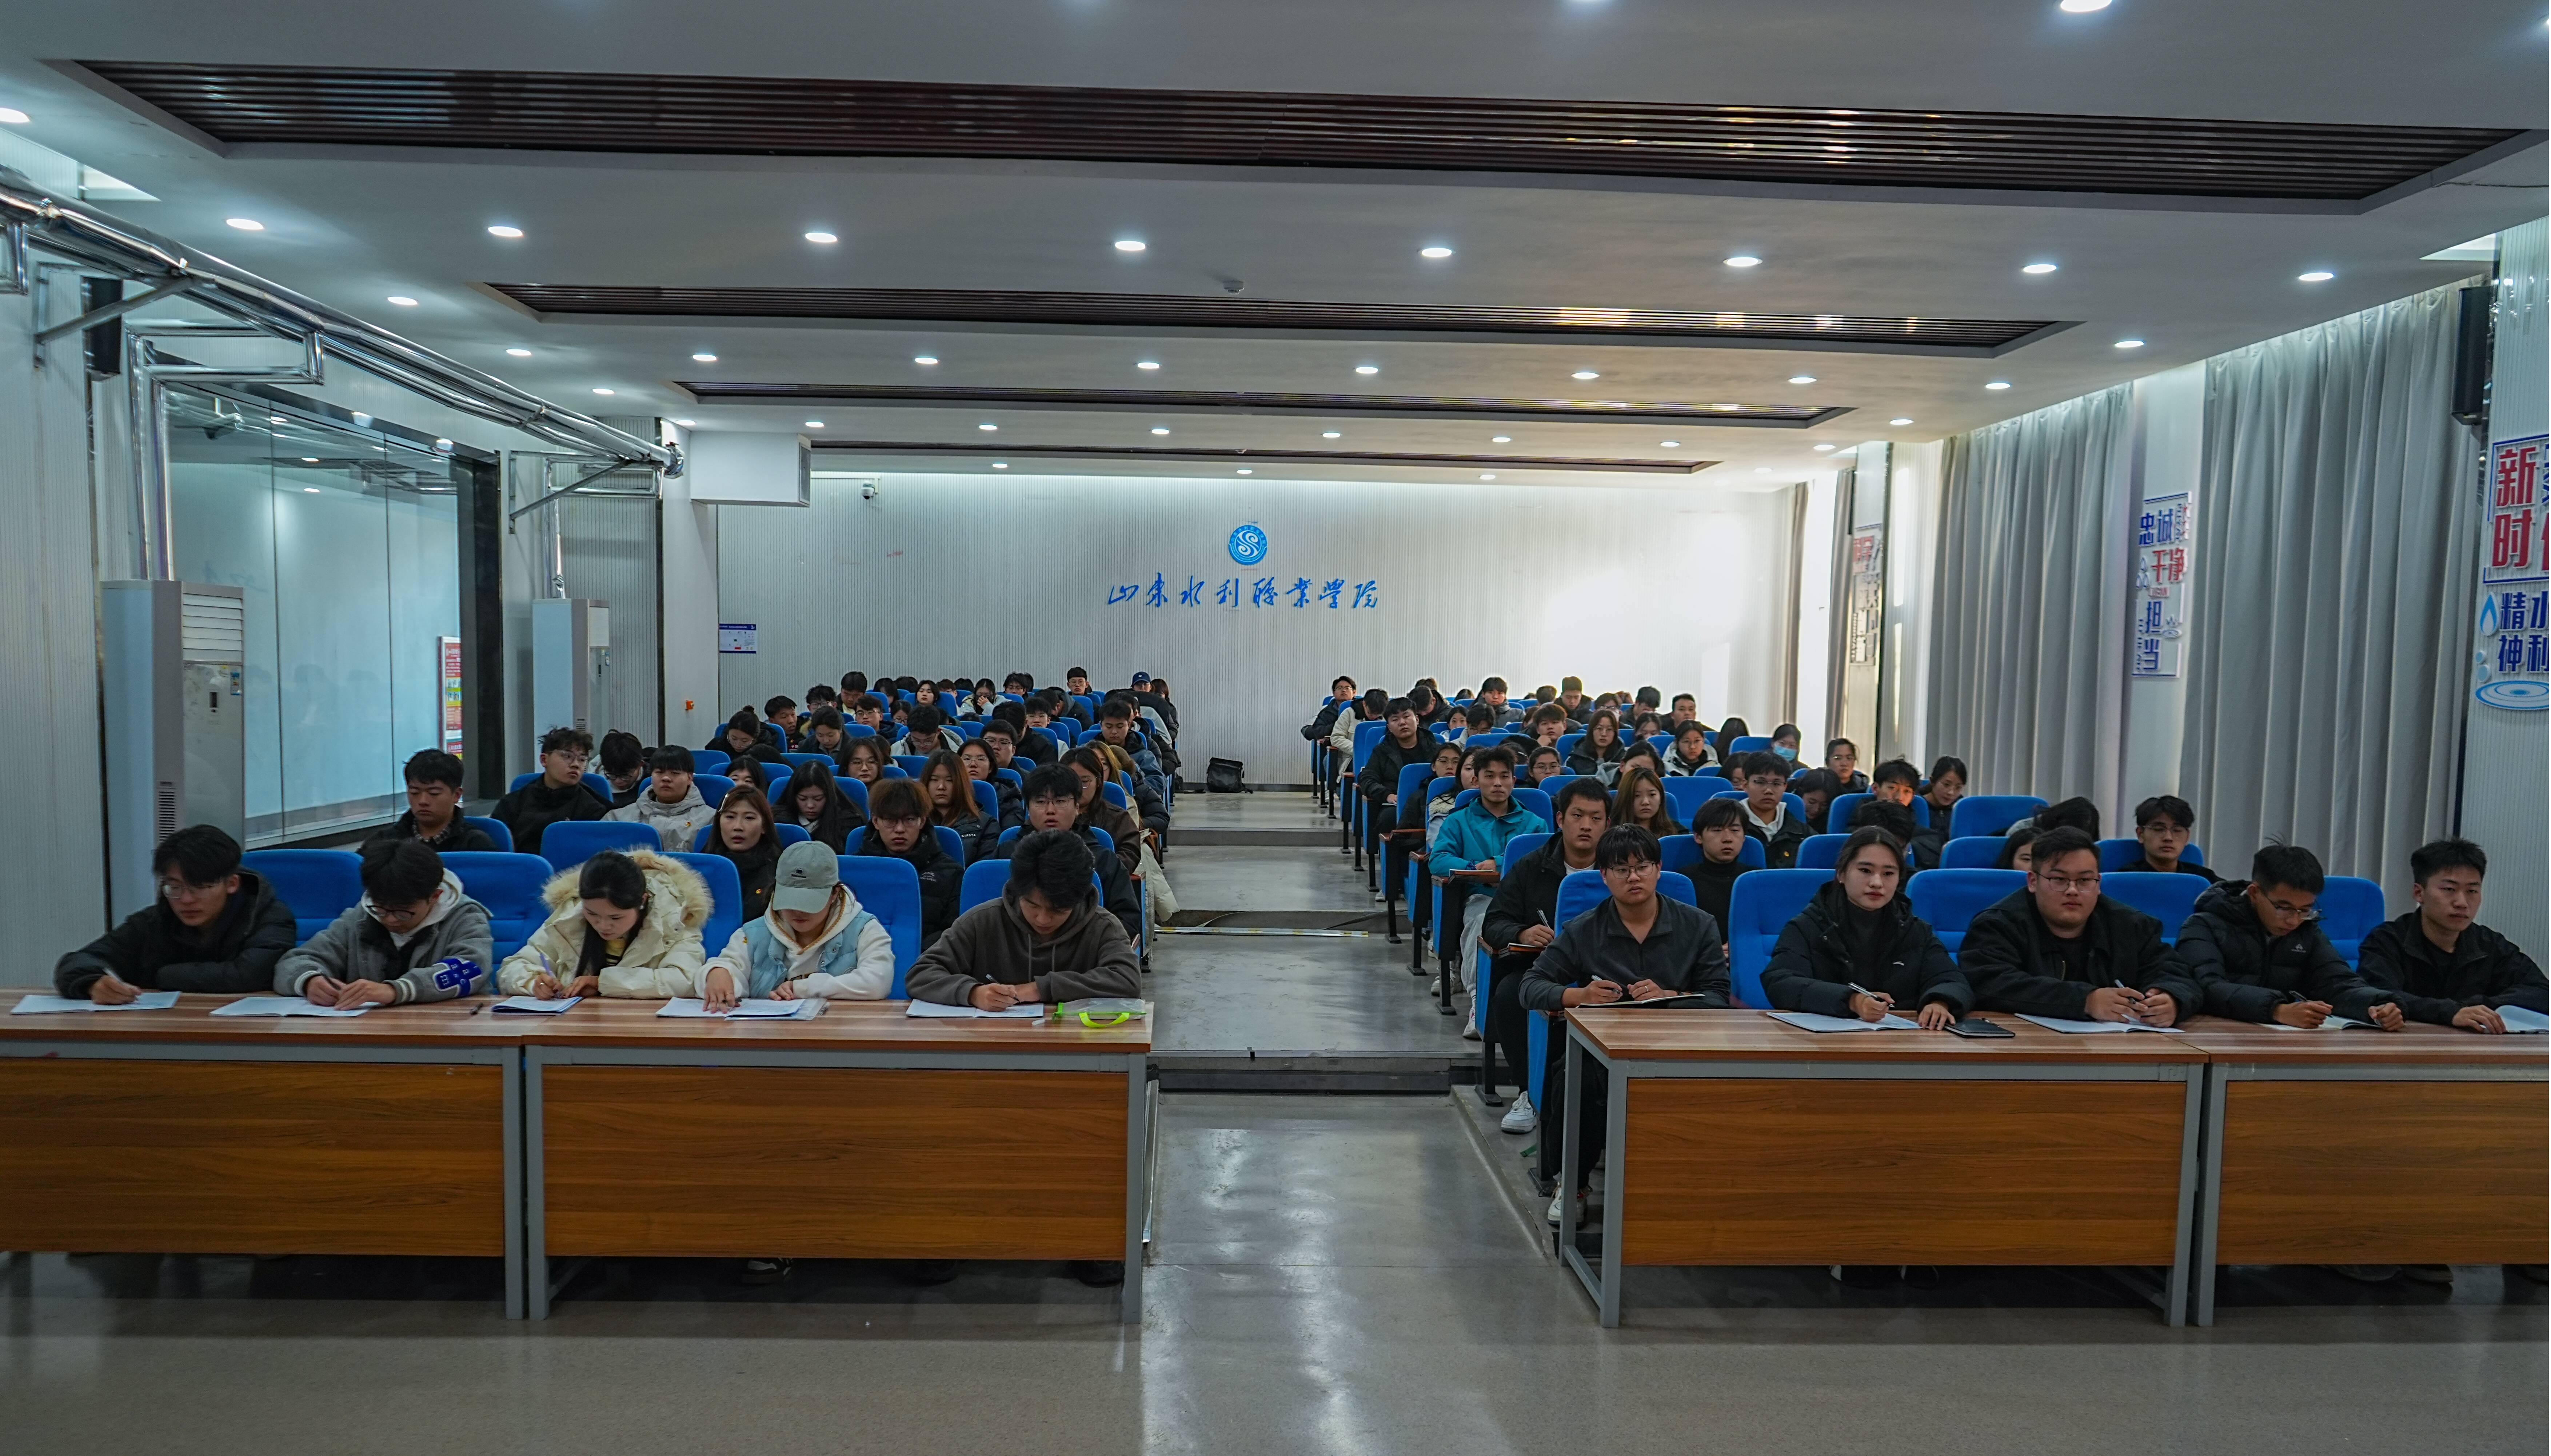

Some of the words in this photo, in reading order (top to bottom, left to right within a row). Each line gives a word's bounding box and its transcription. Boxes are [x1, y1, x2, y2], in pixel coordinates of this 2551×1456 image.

[2139, 508, 2173, 545] 忠诚
[2151, 547, 2183, 582] 干净
[2143, 600, 2163, 670] 担当
